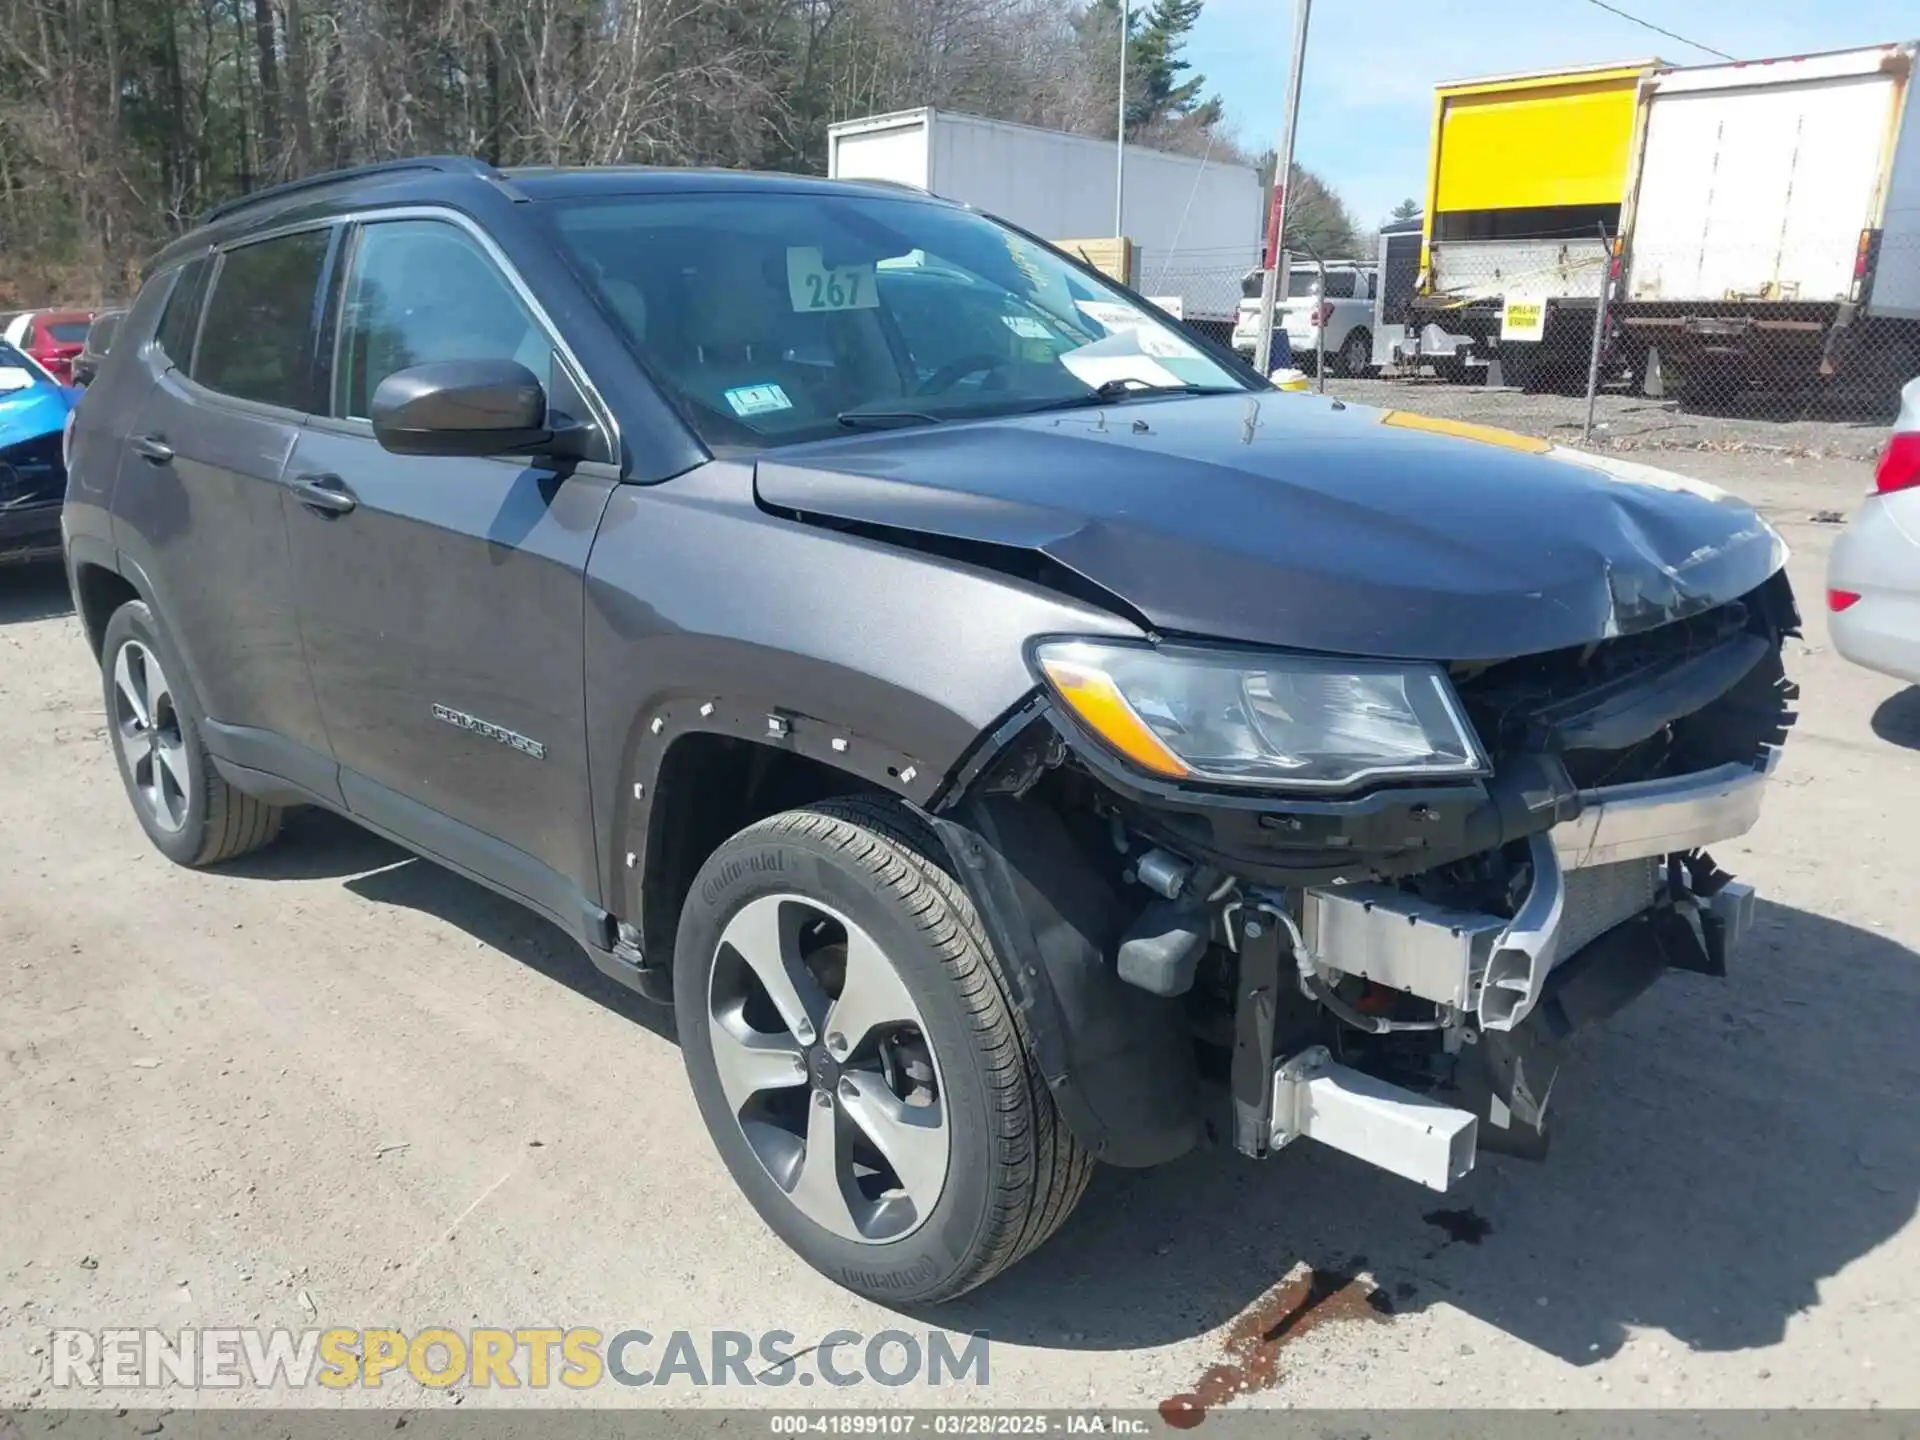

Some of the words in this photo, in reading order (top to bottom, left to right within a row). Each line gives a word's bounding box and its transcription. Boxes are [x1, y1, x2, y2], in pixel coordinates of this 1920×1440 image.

[805, 272, 861, 308] 267
[432, 702, 547, 760] COMPASS
[701, 849, 785, 906] Continental
